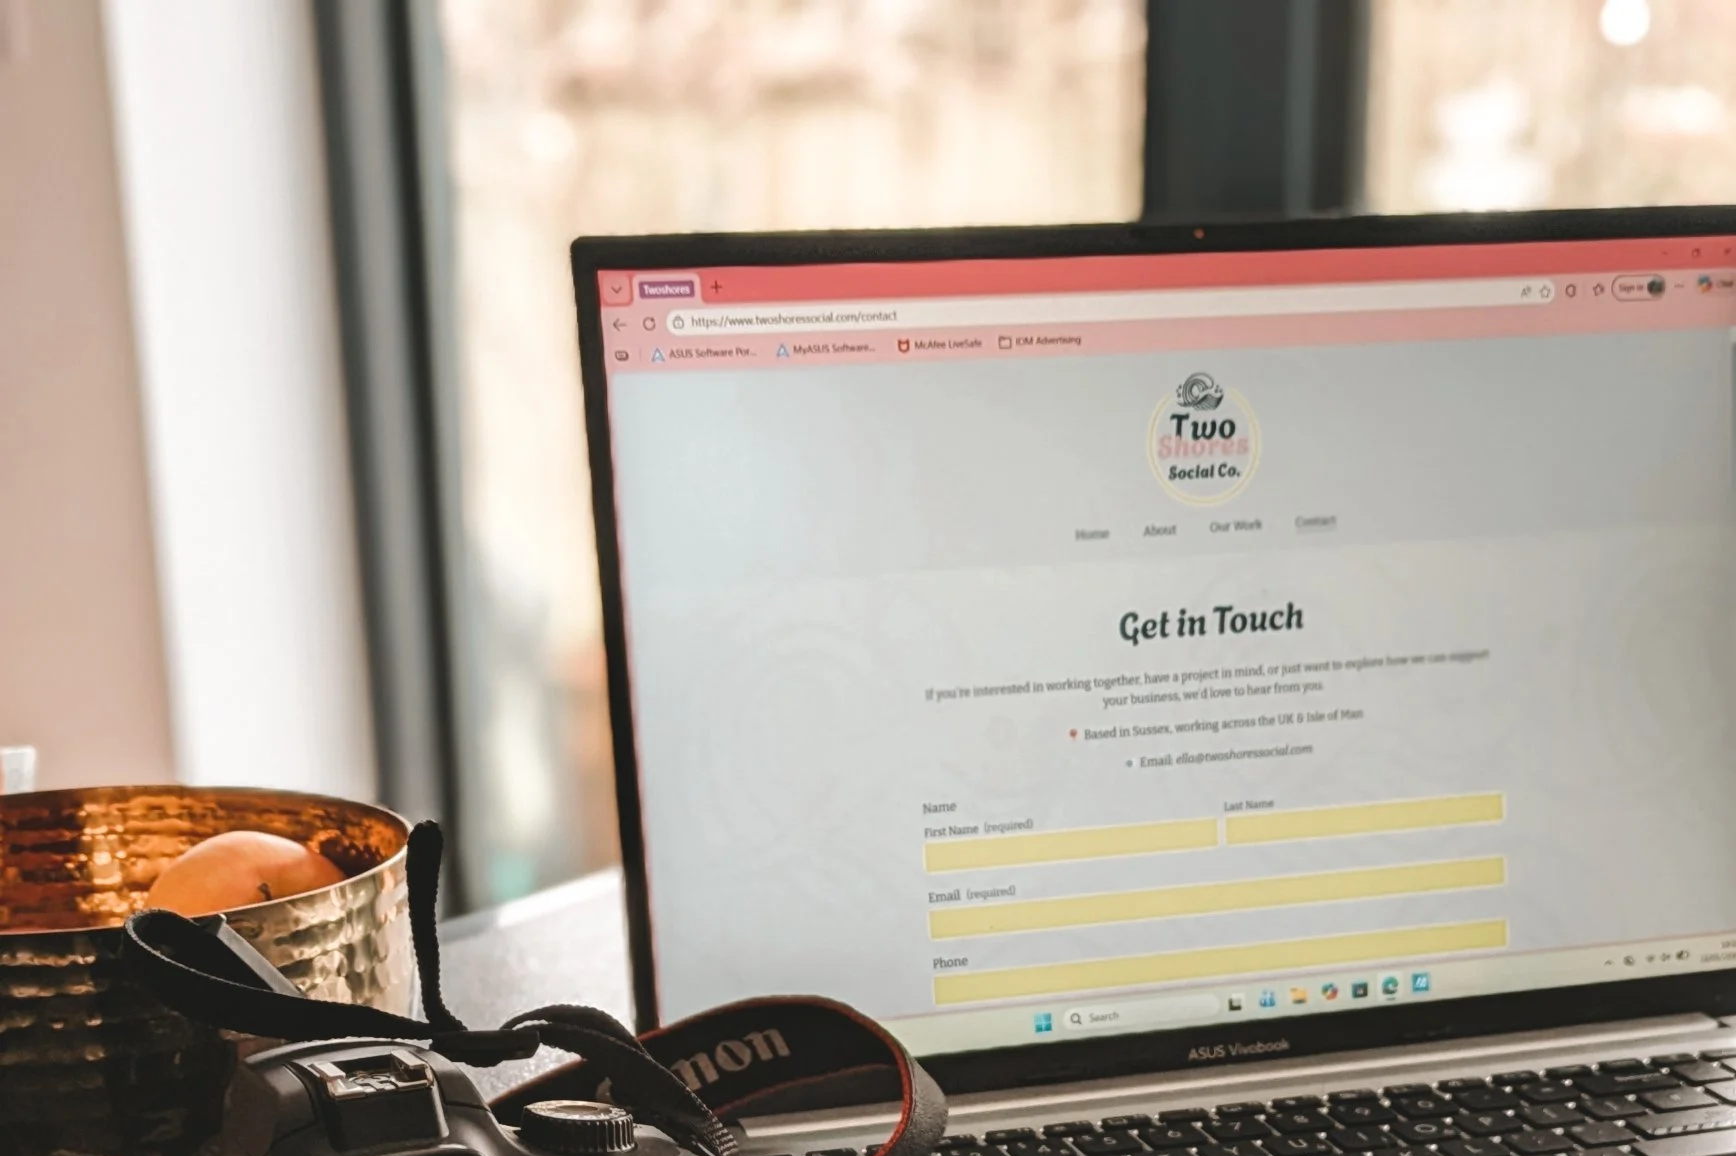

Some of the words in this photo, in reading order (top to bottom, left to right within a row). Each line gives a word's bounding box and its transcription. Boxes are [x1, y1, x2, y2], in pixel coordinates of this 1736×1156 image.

[643, 284, 691, 296] Twoshores
[690, 310, 898, 329] https://www.twoshoressocial.com/contact
[914, 341, 947, 350] McAfee
[1035, 336, 1082, 347] Advertising
[669, 350, 693, 359] ASUS
[695, 347, 734, 358] Software
[1169, 413, 1236, 441] Two
[1158, 435, 1249, 459] Shores
[1168, 464, 1214, 480] Social
[1217, 463, 1241, 478] Co.
[1210, 521, 1230, 533] Our
[1233, 518, 1262, 531] Work
[1295, 515, 1337, 530] Contact
[1075, 529, 1110, 541] Home
[1143, 524, 1176, 538] About
[1119, 611, 1169, 646] Get
[1177, 608, 1206, 638] in
[1213, 602, 1304, 636] Touch
[973, 681, 1030, 697] interested
[1033, 681, 1044, 693] in
[1046, 678, 1092, 692] working
[1093, 674, 1143, 691] together,
[1144, 672, 1170, 684] have
[1172, 673, 1178, 682] a
[1181, 668, 1219, 684] project
[1221, 667, 1232, 678] in
[1235, 663, 1265, 678] mind,
[1267, 665, 1279, 676] or
[1281, 662, 1301, 677] just
[1303, 660, 1329, 673] want
[1332, 660, 1342, 670] to
[1102, 694, 1128, 710] your
[1130, 690, 1182, 705] business,
[1210, 686, 1231, 699] love
[1234, 685, 1245, 697] to
[1247, 683, 1272, 695] hear
[1274, 682, 1300, 694] from
[1083, 726, 1117, 741] Based
[1120, 726, 1130, 737] in
[1132, 724, 1172, 736] Sussex,
[1174, 720, 1219, 734] working
[1221, 718, 1257, 730] across
[1258, 714, 1275, 727] the
[1277, 713, 1295, 725] UK
[1307, 711, 1326, 723] Isle
[1327, 708, 1339, 720] of
[1340, 708, 1364, 720] Man
[922, 800, 957, 815] Name
[1223, 800, 1241, 812] Last
[1243, 798, 1274, 811] Name
[924, 826, 947, 838] First
[948, 823, 979, 837] Name
[983, 818, 1034, 835] (required)
[928, 889, 961, 904] Email
[966, 884, 1016, 901] (required)
[932, 955, 969, 971] Phone
[1088, 1010, 1119, 1024] Search
[1188, 1045, 1226, 1061] ASUS
[1230, 1039, 1290, 1056] Vivobook
[670, 1028, 791, 1091] non
